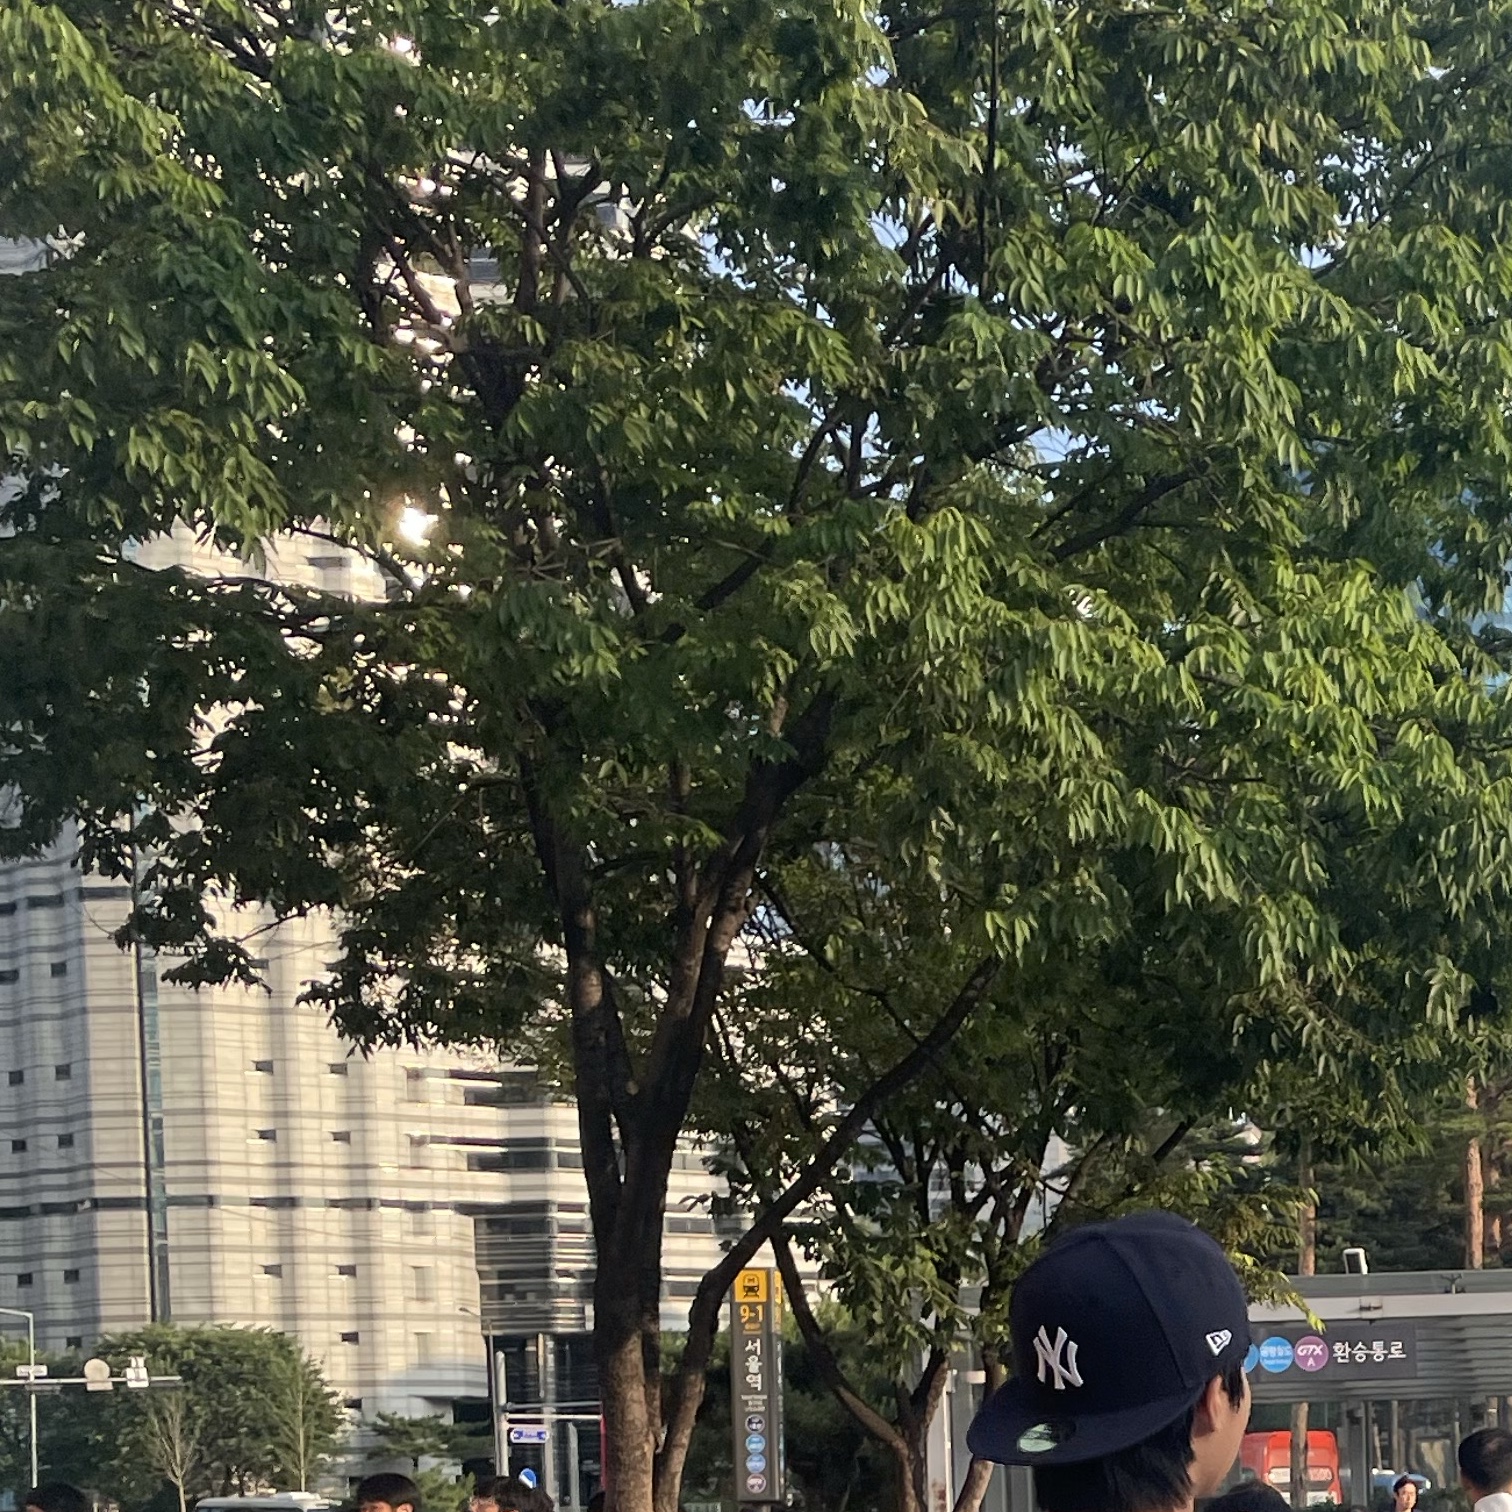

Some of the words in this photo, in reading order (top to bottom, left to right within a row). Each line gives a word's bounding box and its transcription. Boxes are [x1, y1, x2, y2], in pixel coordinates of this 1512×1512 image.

[740, 1304, 763, 1323] 9-1
[1032, 1324, 1084, 1390] NY
[1296, 1344, 1324, 1357] GTX
[1332, 1340, 1407, 1364] 환승통로
[744, 1337, 763, 1391] 서울역
